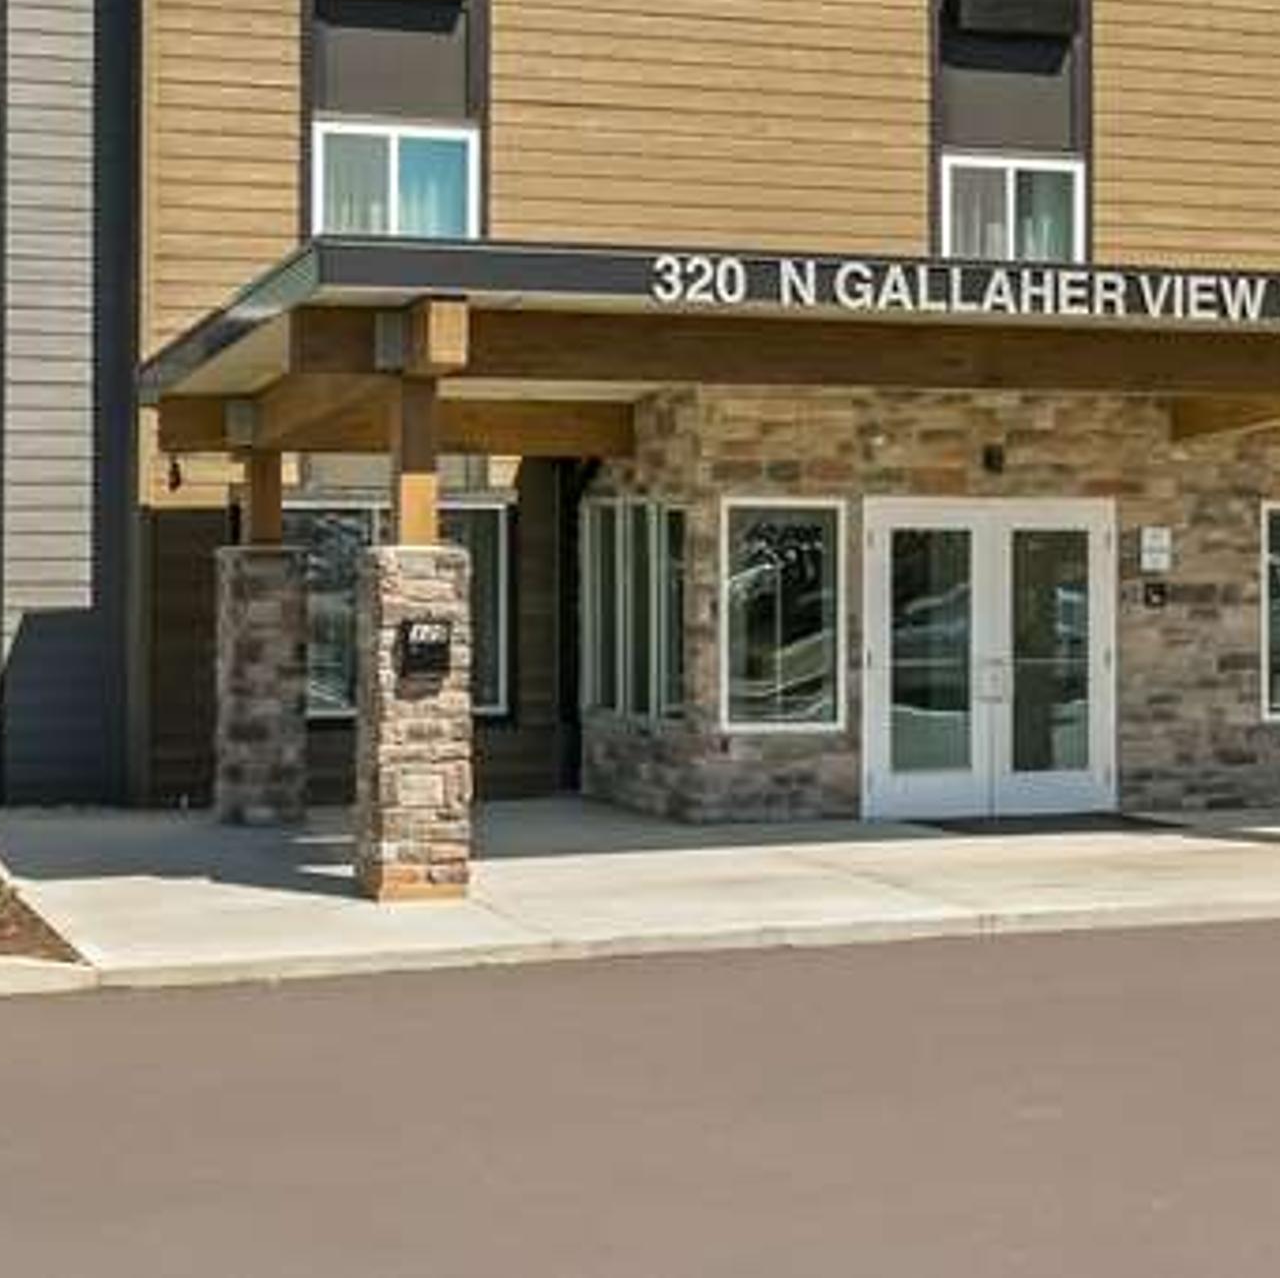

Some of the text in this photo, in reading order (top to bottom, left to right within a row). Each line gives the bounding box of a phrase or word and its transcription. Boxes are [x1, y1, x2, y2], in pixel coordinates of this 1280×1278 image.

[651, 255, 746, 305] 320
[779, 259, 818, 306] N
[834, 261, 1126, 317] GALLAHER
[1140, 275, 1269, 322] VIEW
